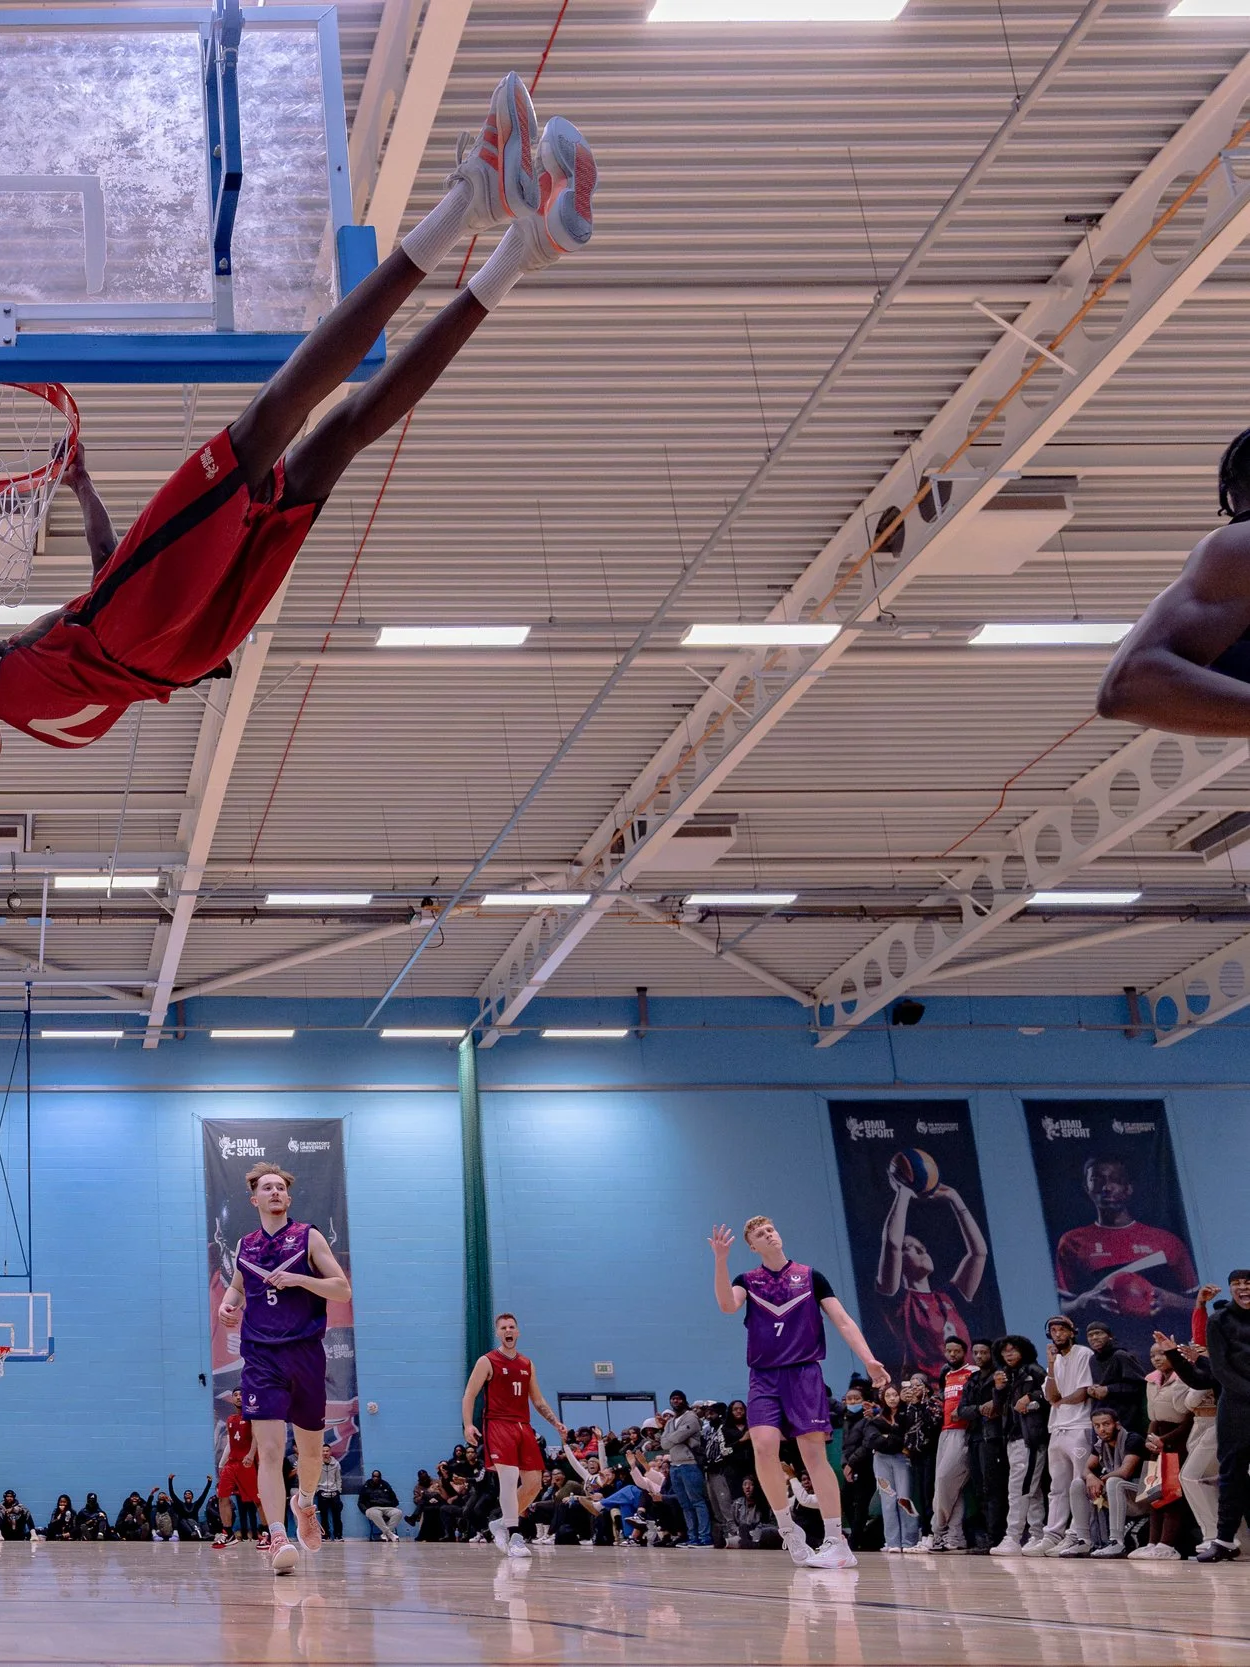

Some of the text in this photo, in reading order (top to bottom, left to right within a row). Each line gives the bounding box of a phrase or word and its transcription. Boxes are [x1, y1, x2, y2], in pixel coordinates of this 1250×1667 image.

[864, 1120, 886, 1129] DMU
[1059, 1120, 1082, 1129] DMU
[865, 1128, 894, 1139] SPORT
[1061, 1128, 1091, 1138] SPORT
[236, 1139, 258, 1148] DMU
[236, 1147, 266, 1157] SPORT
[266, 1289, 278, 1306] 5
[774, 1322, 785, 1337] 7
[512, 1381, 522, 1396] 11
[234, 1430, 241, 1441] 4
